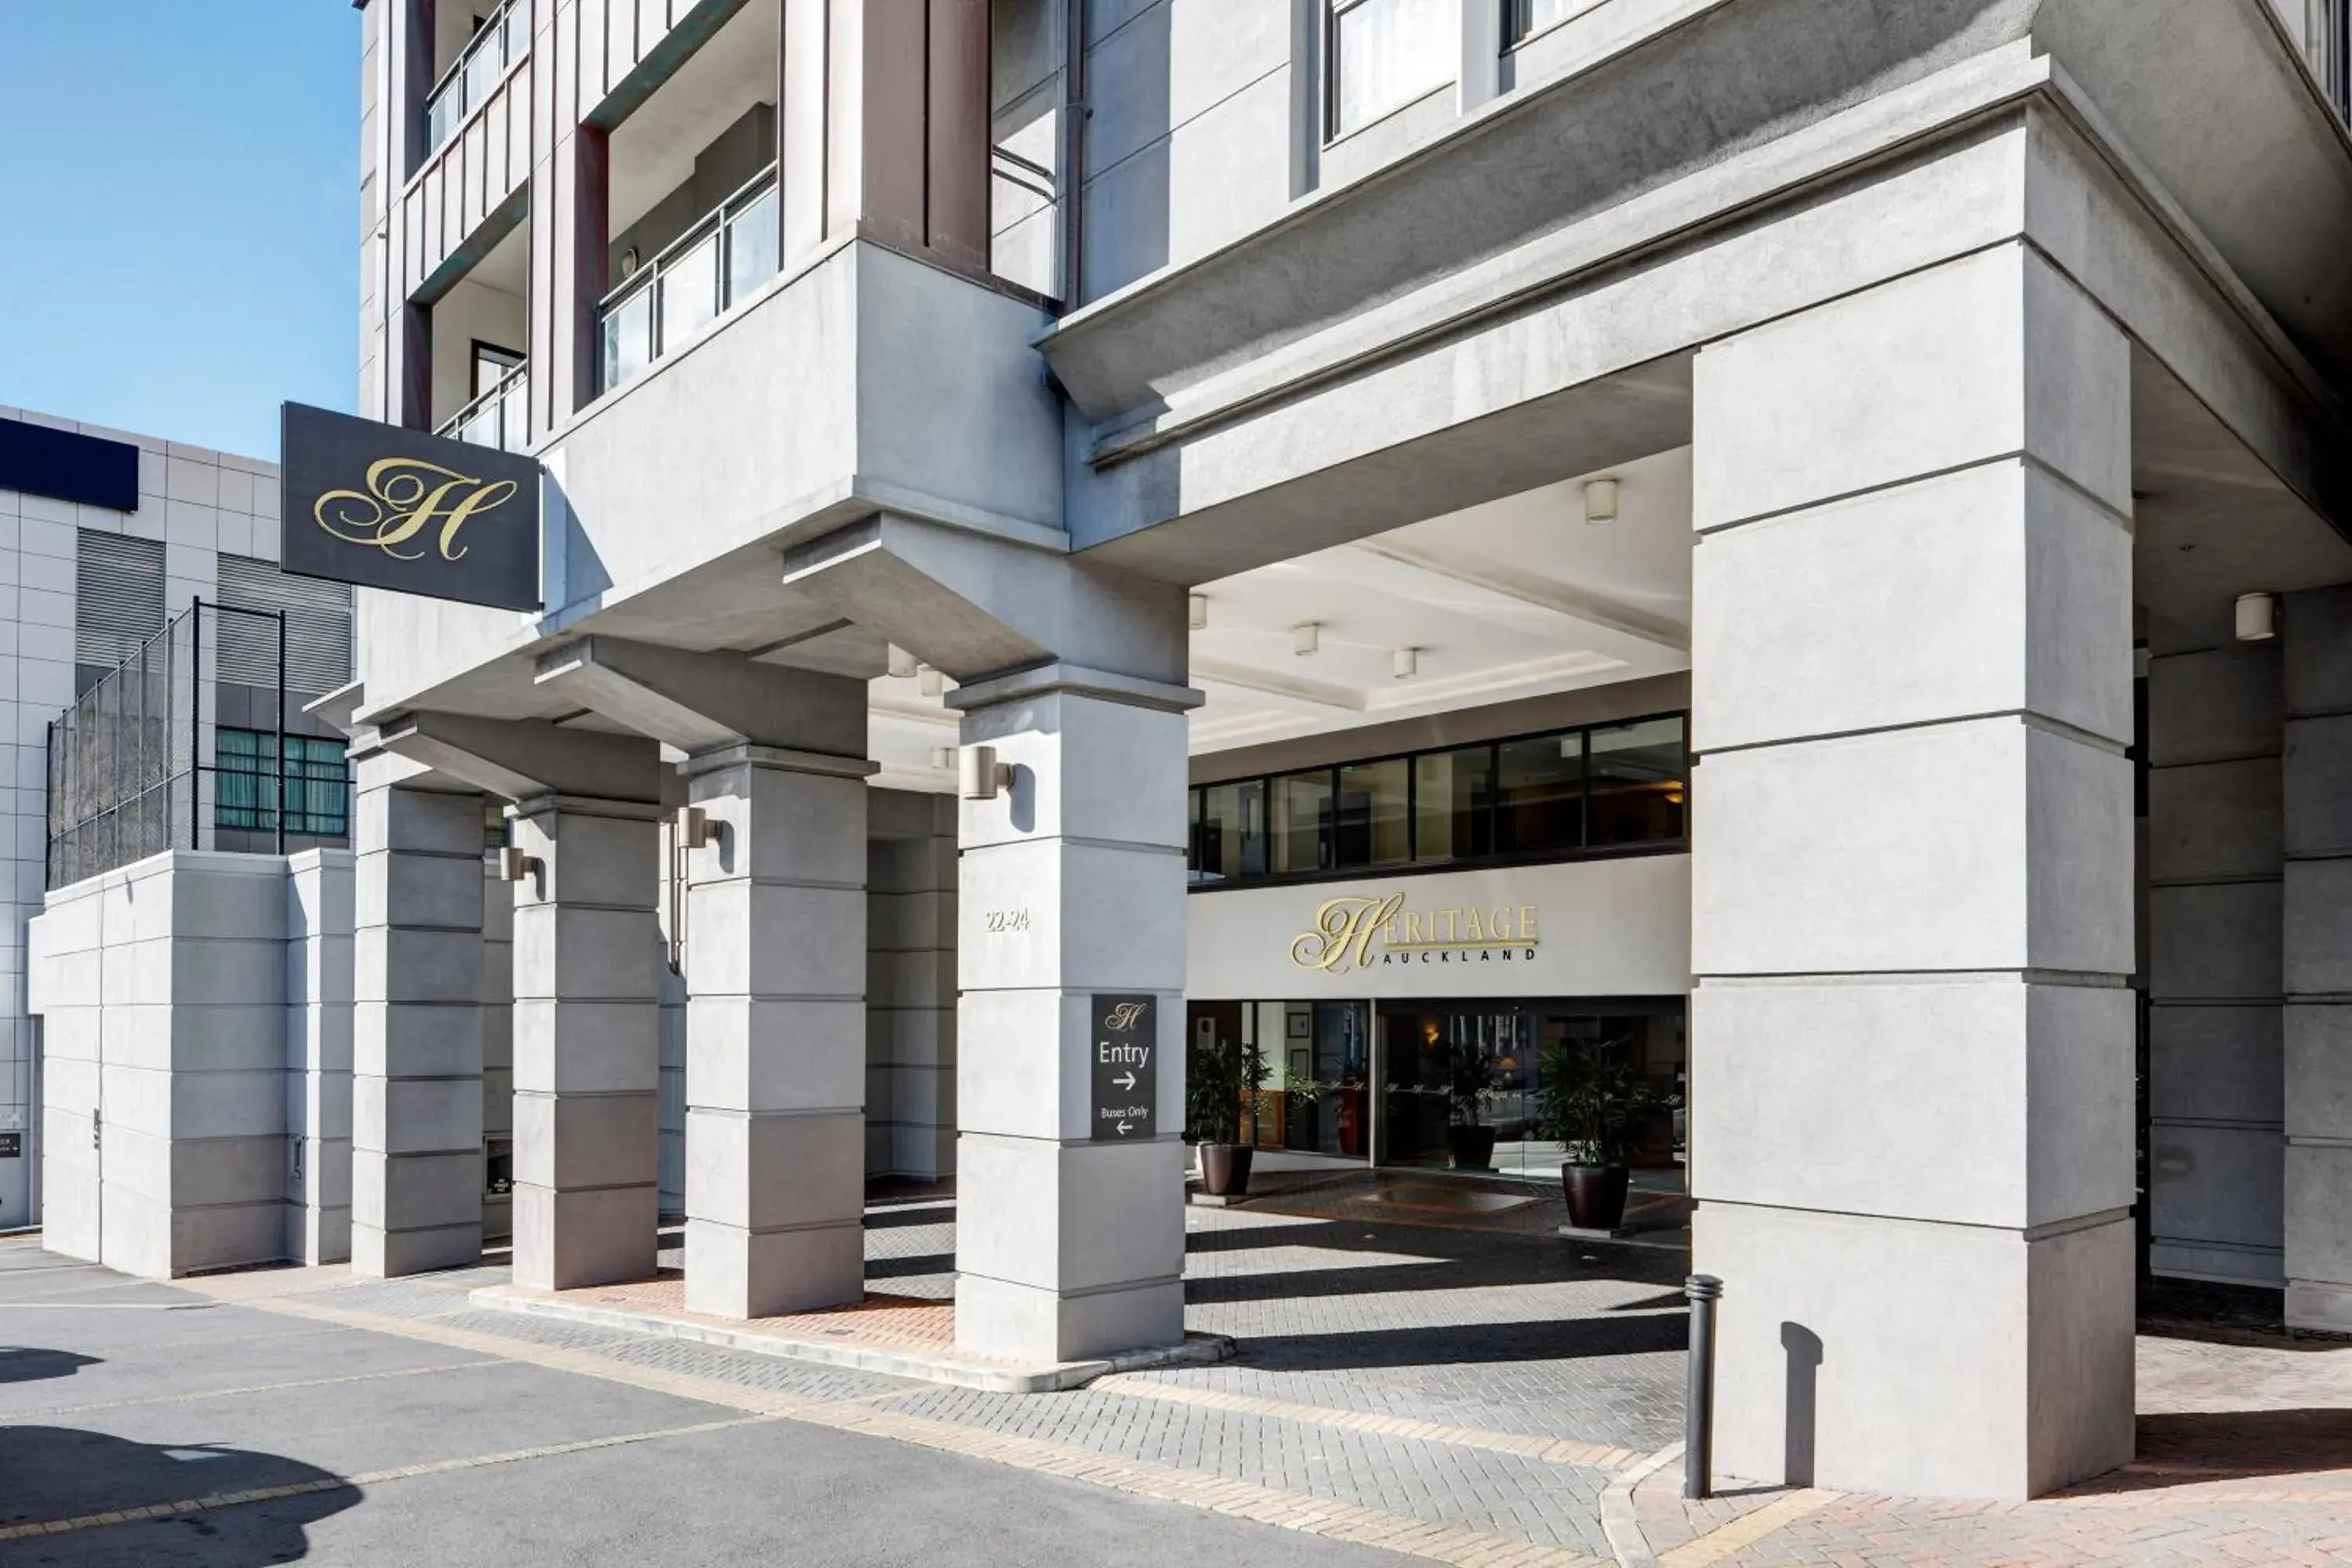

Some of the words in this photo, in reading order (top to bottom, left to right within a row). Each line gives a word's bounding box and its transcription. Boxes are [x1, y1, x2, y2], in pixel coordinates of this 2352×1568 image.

[314, 457, 518, 561] H
[985, 907, 1029, 932] 22-24
[1290, 891, 1540, 975] HERITAGE
[1383, 947, 1536, 965] AUCKLAND
[1099, 1040, 1149, 1069] Entry
[1101, 1107, 1126, 1119] Buses
[1128, 1105, 1149, 1119] Only
